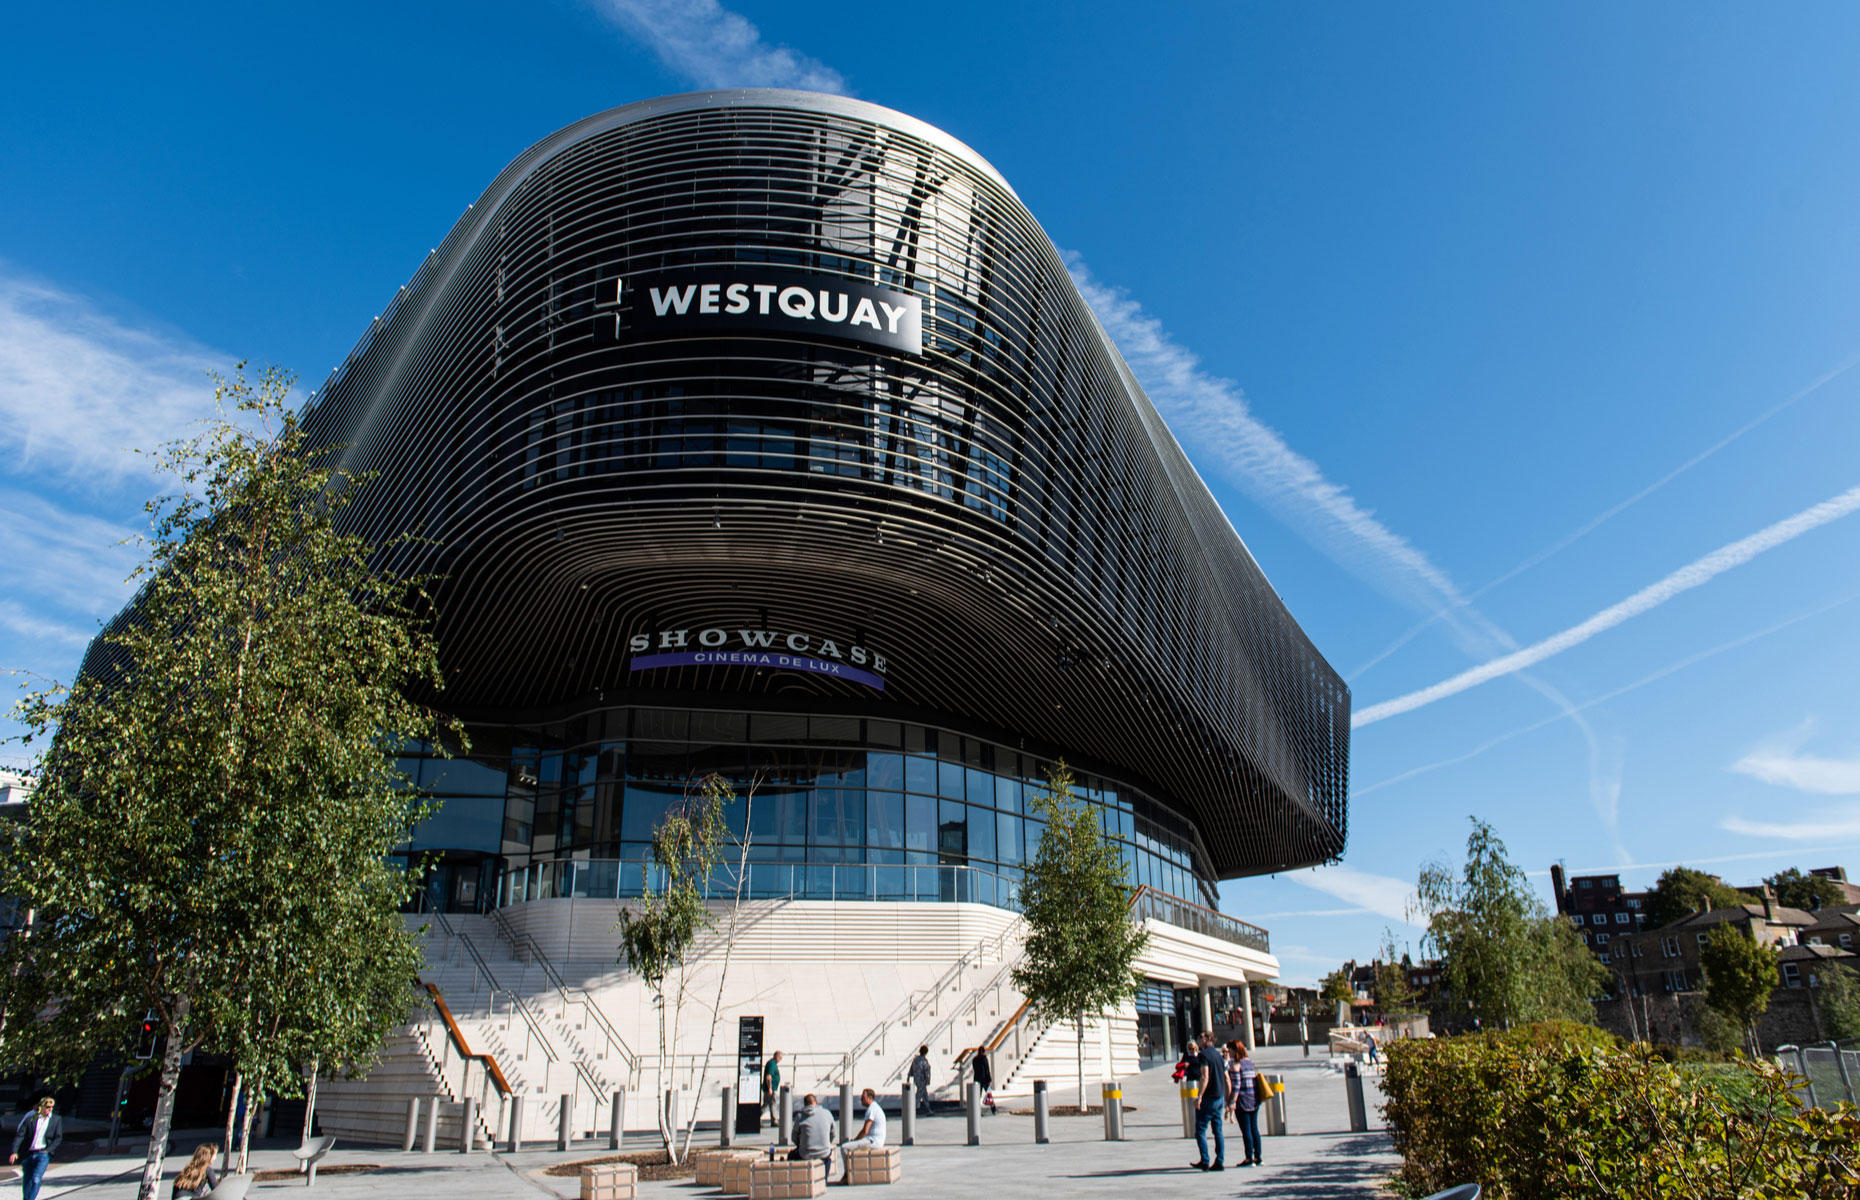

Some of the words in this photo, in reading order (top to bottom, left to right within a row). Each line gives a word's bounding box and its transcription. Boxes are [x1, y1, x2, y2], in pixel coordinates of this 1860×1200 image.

[649, 283, 907, 334] WESTQUAY
[630, 628, 887, 674] SHOWCASE
[694, 652, 771, 664] CINEMA
[779, 656, 802, 667] DE
[809, 660, 840, 674] LUX
